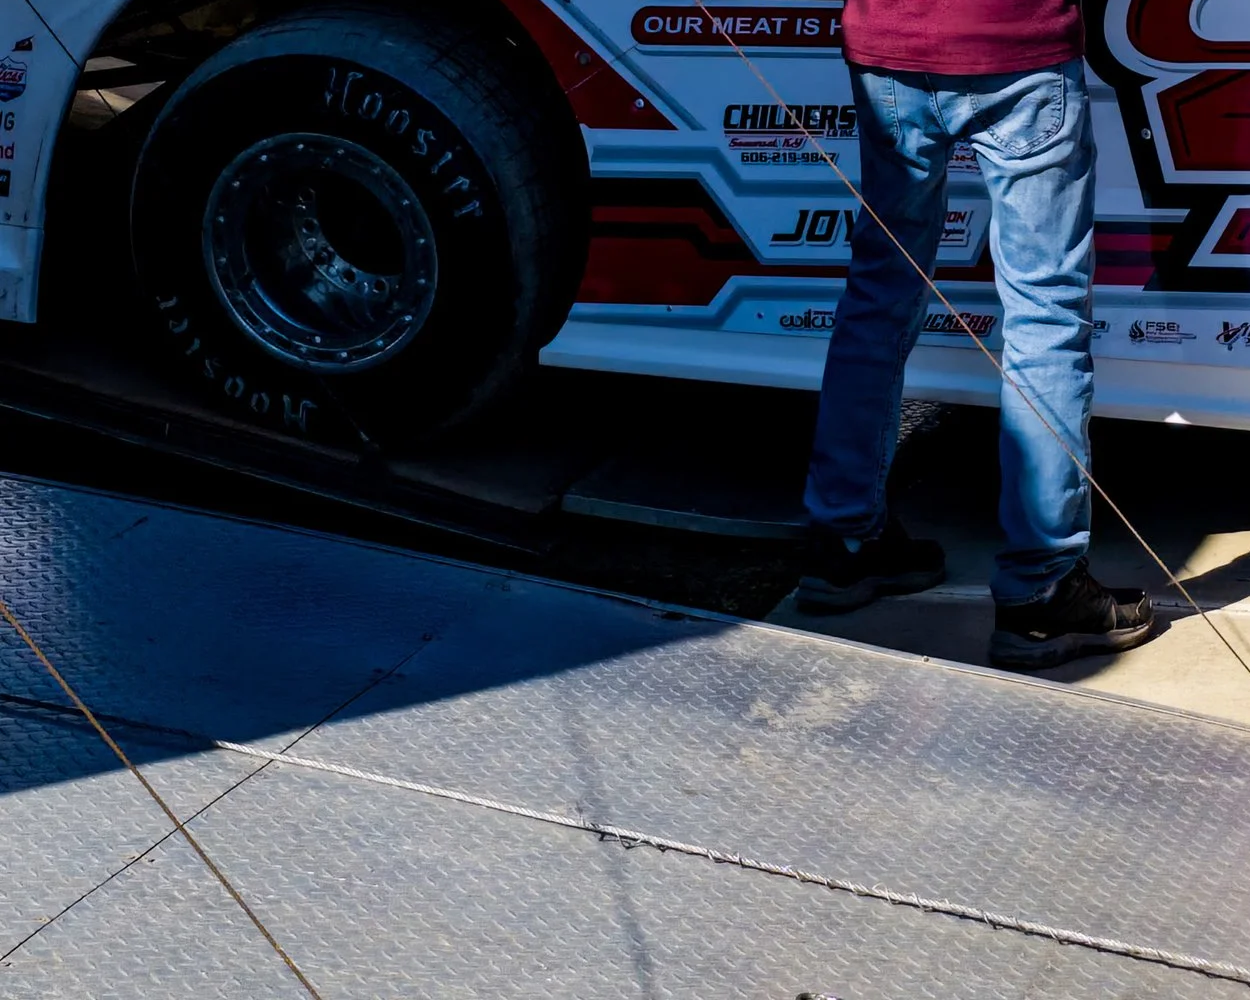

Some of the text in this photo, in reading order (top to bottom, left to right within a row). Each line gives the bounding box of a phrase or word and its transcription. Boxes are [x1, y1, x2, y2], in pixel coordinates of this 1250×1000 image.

[644, 16, 704, 34] OUR
[712, 17, 788, 35] MEAT
[795, 18, 820, 35] IS
[723, 104, 857, 130] CHILDERS
[780, 309, 836, 328] wilw
[1146, 321, 1177, 332] FSE
